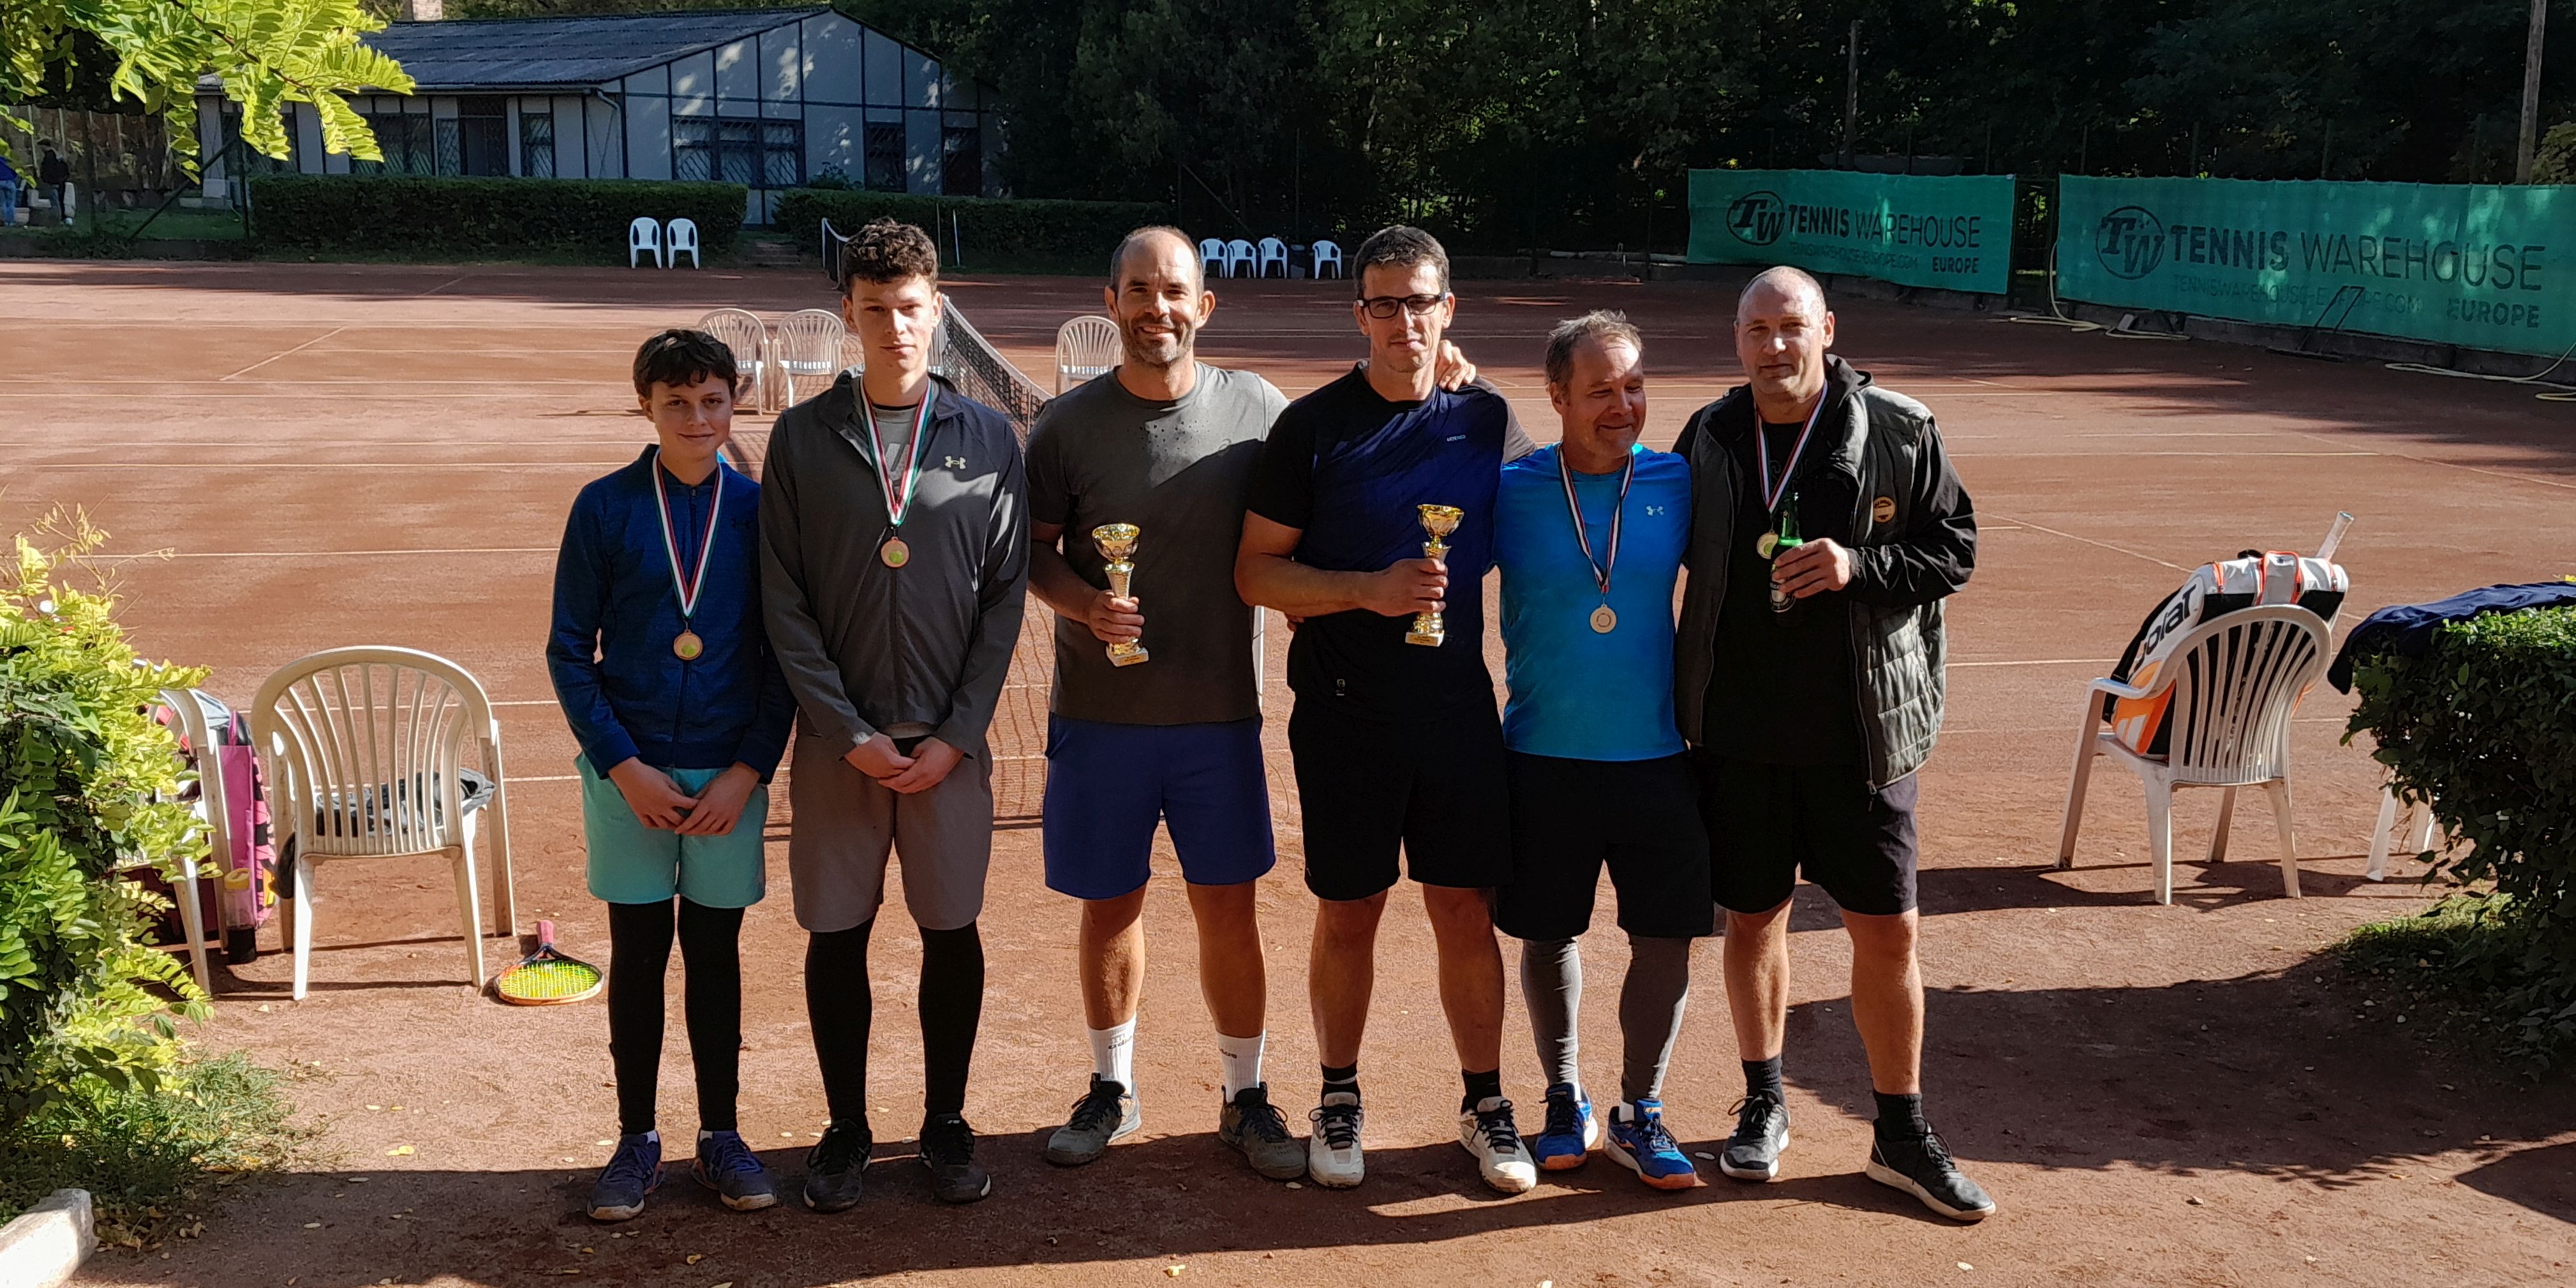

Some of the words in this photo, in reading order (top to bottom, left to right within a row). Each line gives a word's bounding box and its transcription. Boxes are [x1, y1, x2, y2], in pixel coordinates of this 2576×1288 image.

[1788, 204, 1850, 238] TENNIS
[1855, 209, 1981, 248] WAREHOUSE
[1932, 256, 1979, 274] EUROPE
[2170, 225, 2289, 271] TENNIS
[2300, 232, 2546, 291] WAREHOUSE
[2446, 297, 2541, 329] EUROPE
